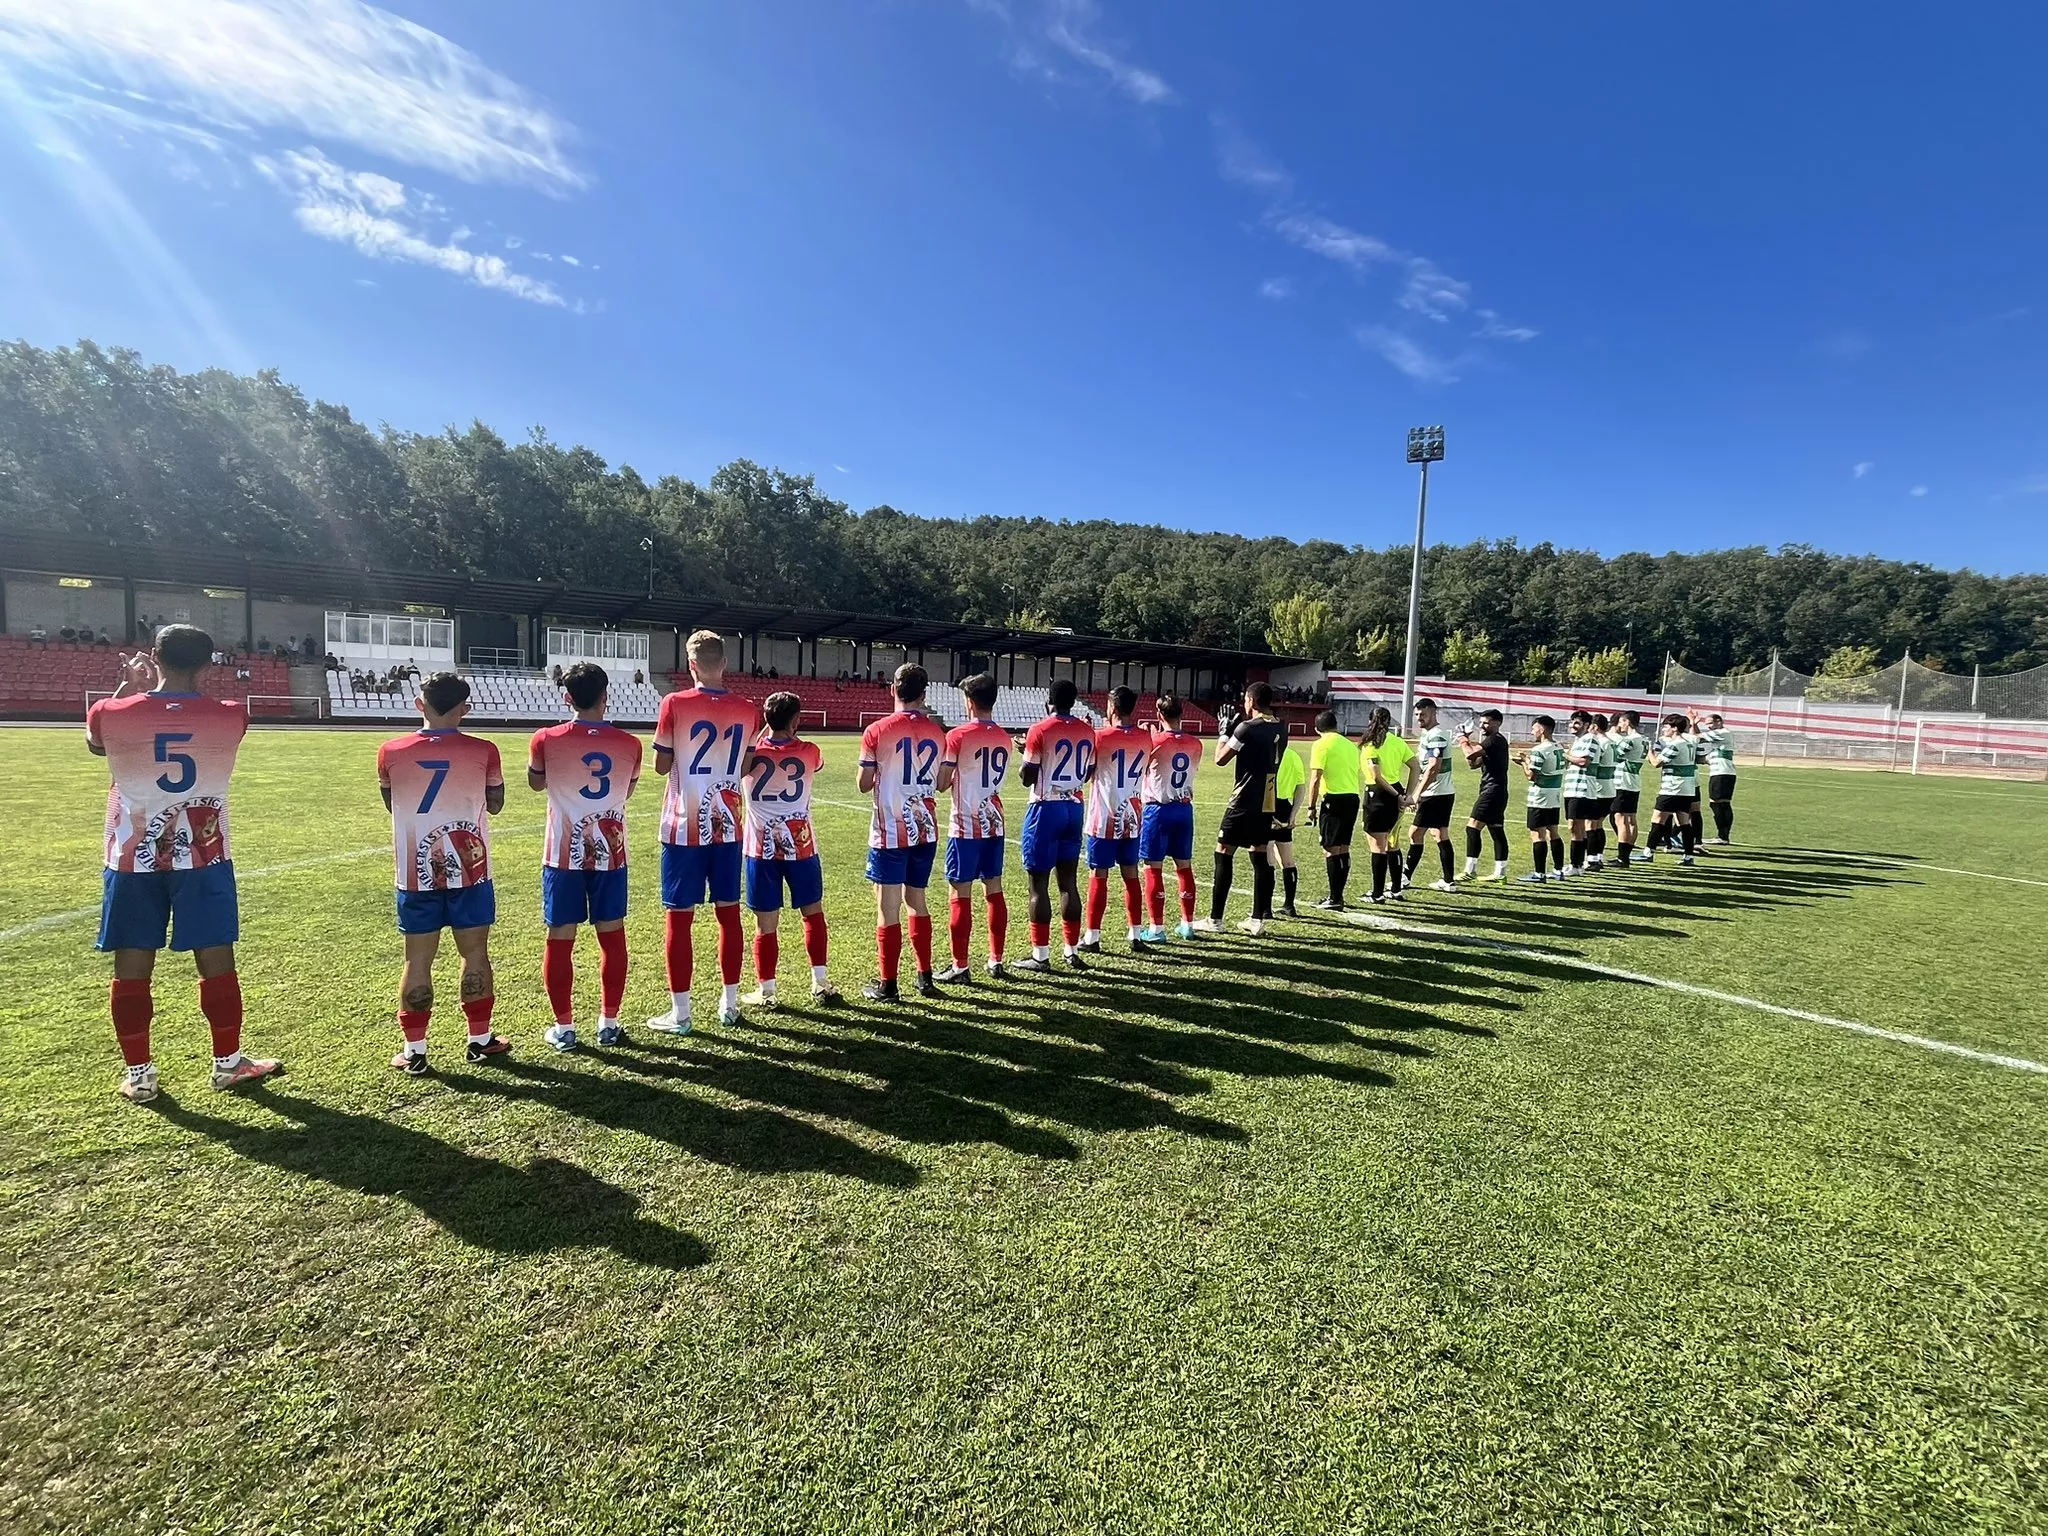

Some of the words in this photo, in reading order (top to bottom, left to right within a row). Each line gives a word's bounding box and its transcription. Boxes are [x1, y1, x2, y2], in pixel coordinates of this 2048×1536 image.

[154, 733, 197, 793] 5
[689, 720, 744, 775] 21
[896, 737, 938, 785] 12
[975, 746, 1008, 788] 19
[1051, 739, 1092, 781] 20
[1111, 749, 1145, 788] 14
[1171, 753, 1189, 789] 8
[416, 760, 450, 814] 7
[579, 752, 612, 800] 3
[751, 755, 806, 803] 23
